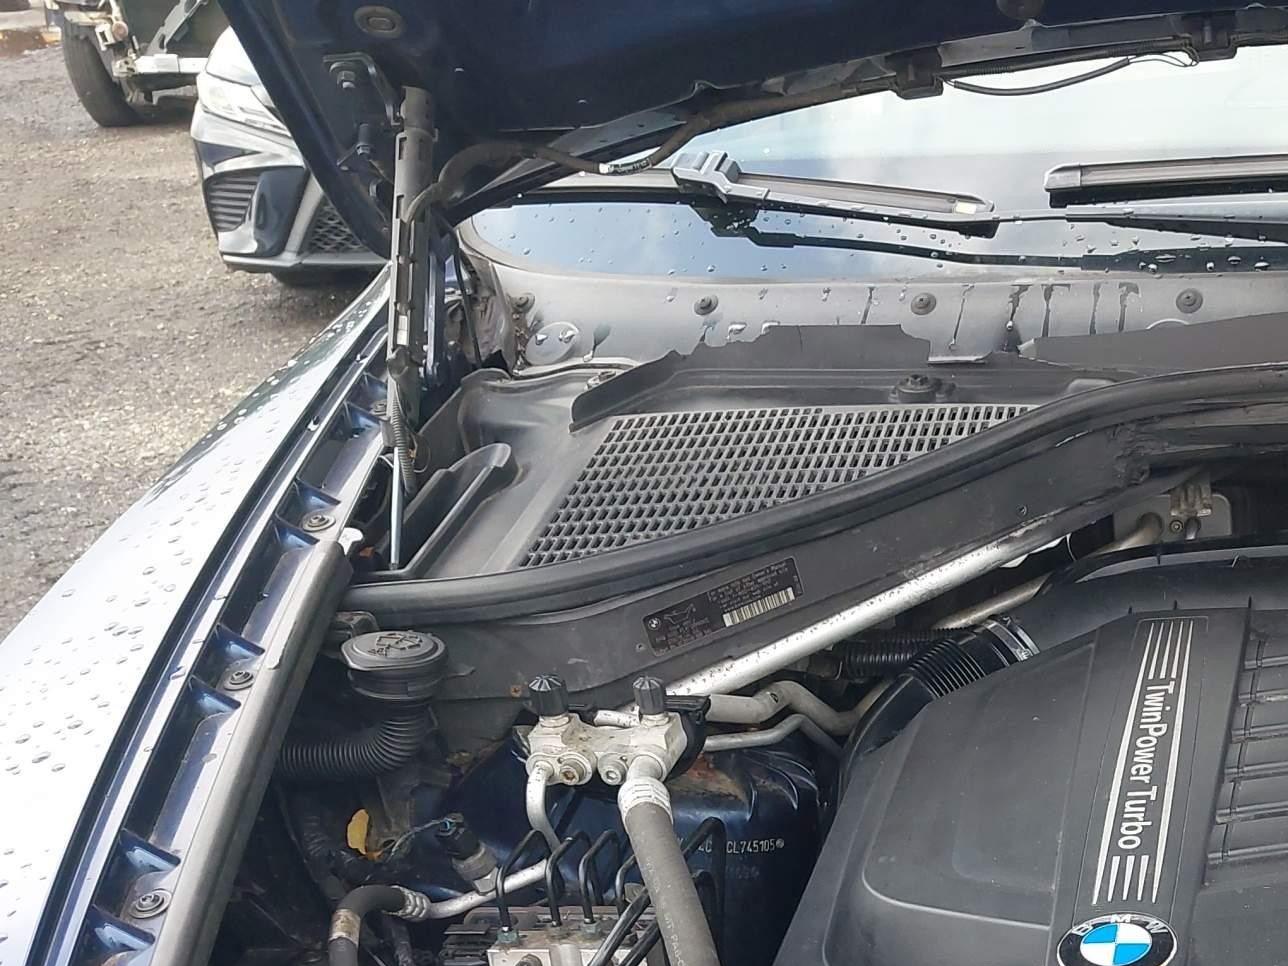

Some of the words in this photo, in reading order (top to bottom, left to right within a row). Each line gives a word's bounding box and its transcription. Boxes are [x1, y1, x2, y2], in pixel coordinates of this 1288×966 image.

[1128, 678, 1175, 784] TwinPower
[1117, 786, 1158, 851] Turbo
[1071, 913, 1169, 937] BMW
